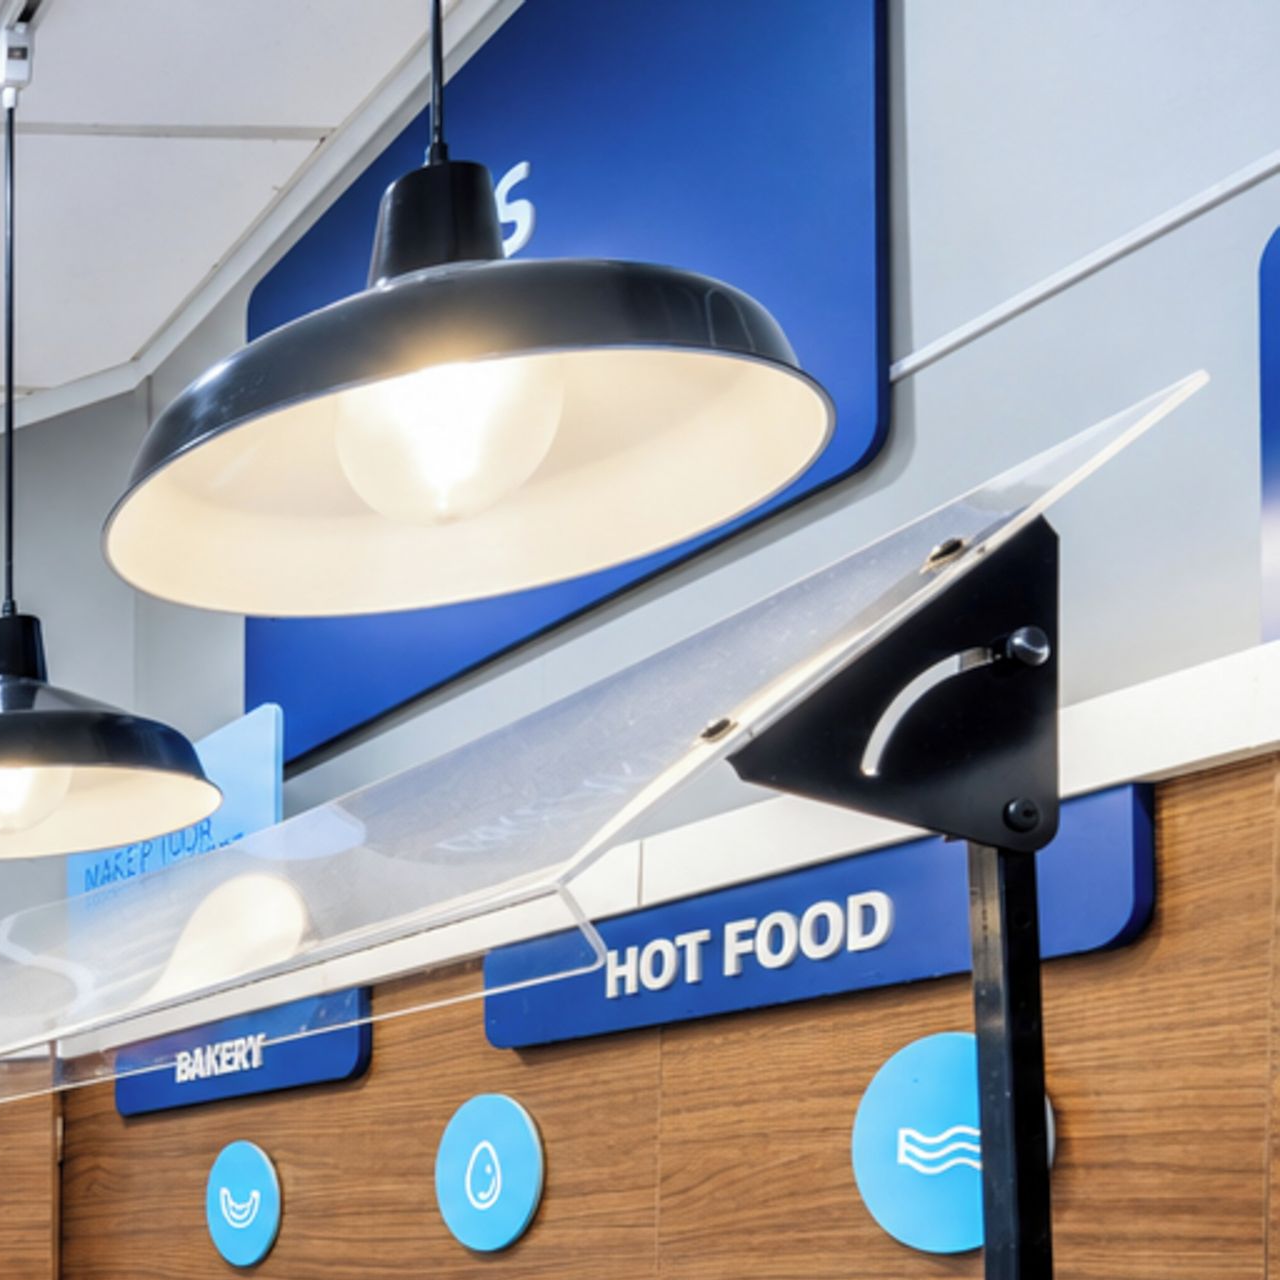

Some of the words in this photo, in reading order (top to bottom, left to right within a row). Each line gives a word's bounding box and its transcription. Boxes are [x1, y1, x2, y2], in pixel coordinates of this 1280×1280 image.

[605, 929, 711, 999] HOT
[723, 890, 893, 976] FOOD
[175, 1033, 266, 1083] BAKERY
